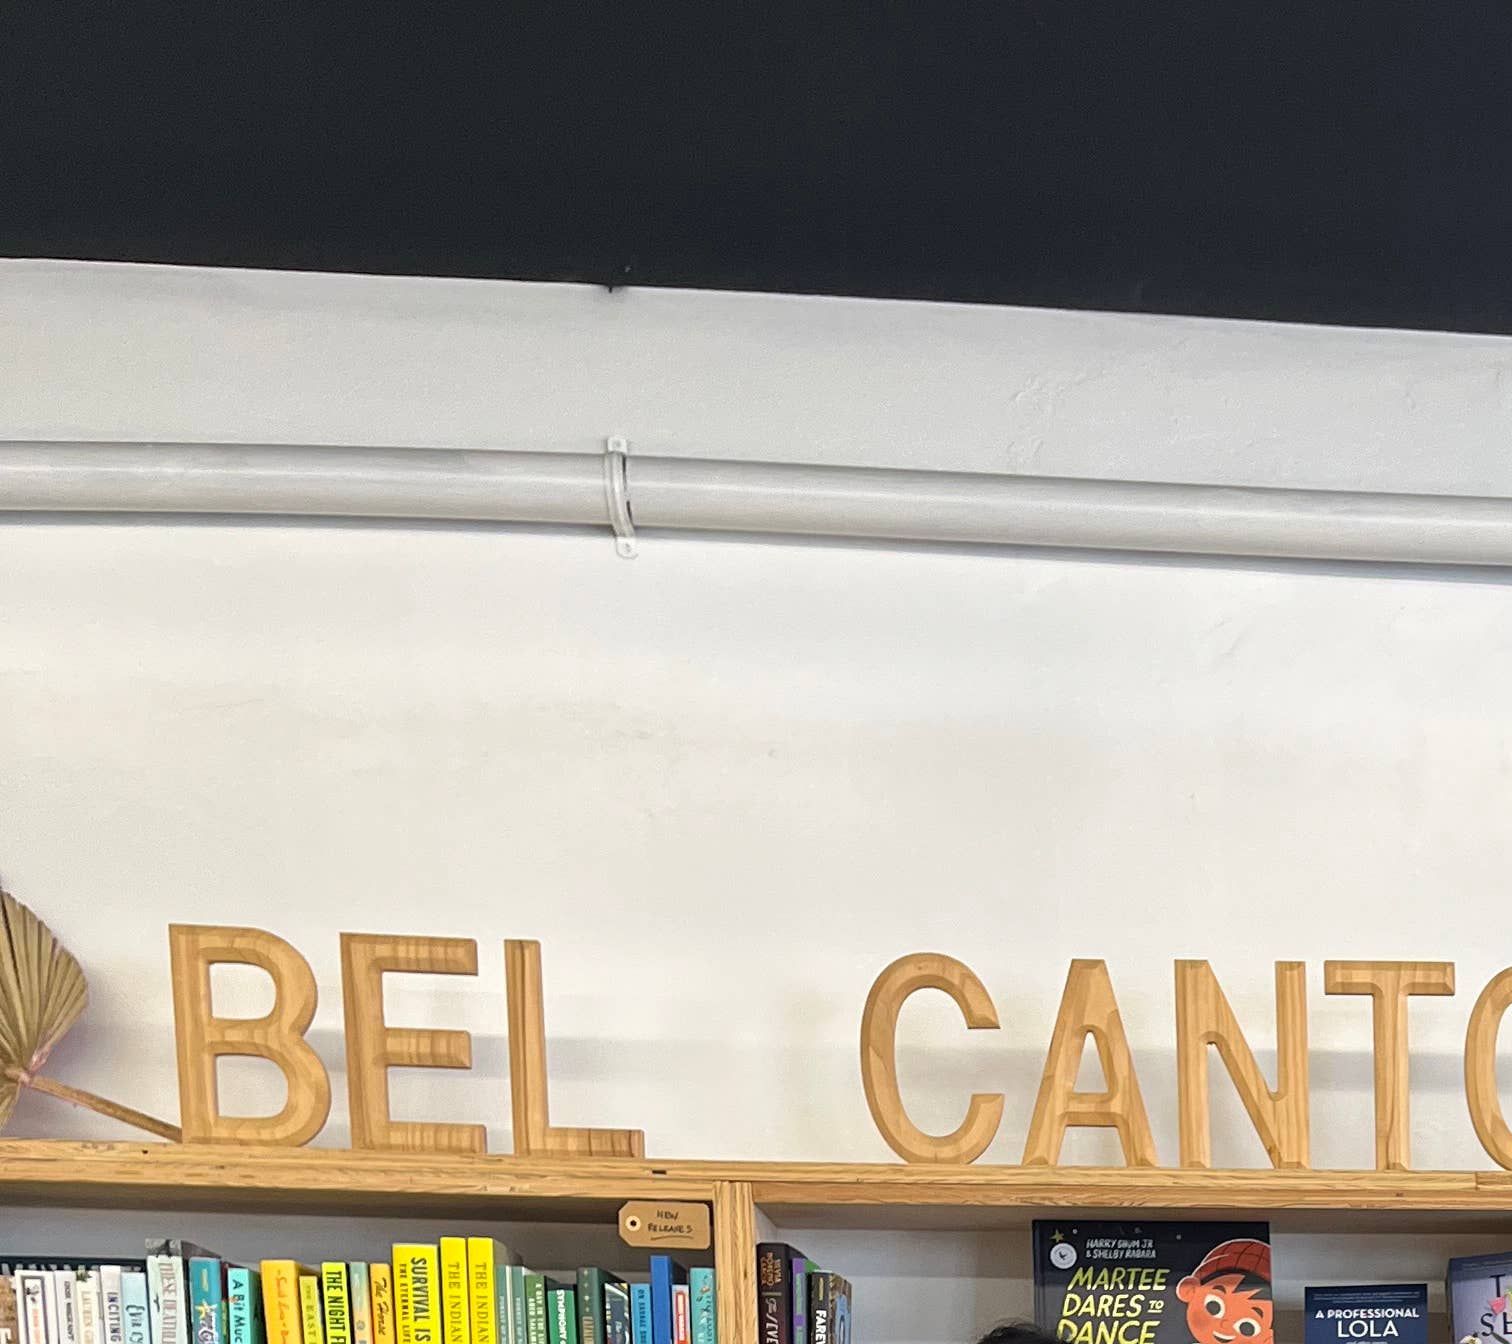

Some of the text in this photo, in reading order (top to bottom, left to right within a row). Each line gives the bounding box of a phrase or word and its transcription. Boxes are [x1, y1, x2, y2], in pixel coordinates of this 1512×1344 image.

[168, 923, 645, 1152] BEL
[1086, 1239, 1153, 1249] HARRY SHUM JR
[1086, 1249, 1156, 1260] & SHELBY RABARA
[326, 1272, 342, 1292] THE
[1069, 1268, 1170, 1291] MARTEE
[411, 1258, 429, 1324] SURVIVAL
[328, 1297, 346, 1331] NIGHT
[1062, 1293, 1163, 1318] DARES TO
[1316, 1308, 1419, 1319] A PROFESSIONAL
[415, 1330, 430, 1343] IS
[1338, 1321, 1399, 1338] LOLA
